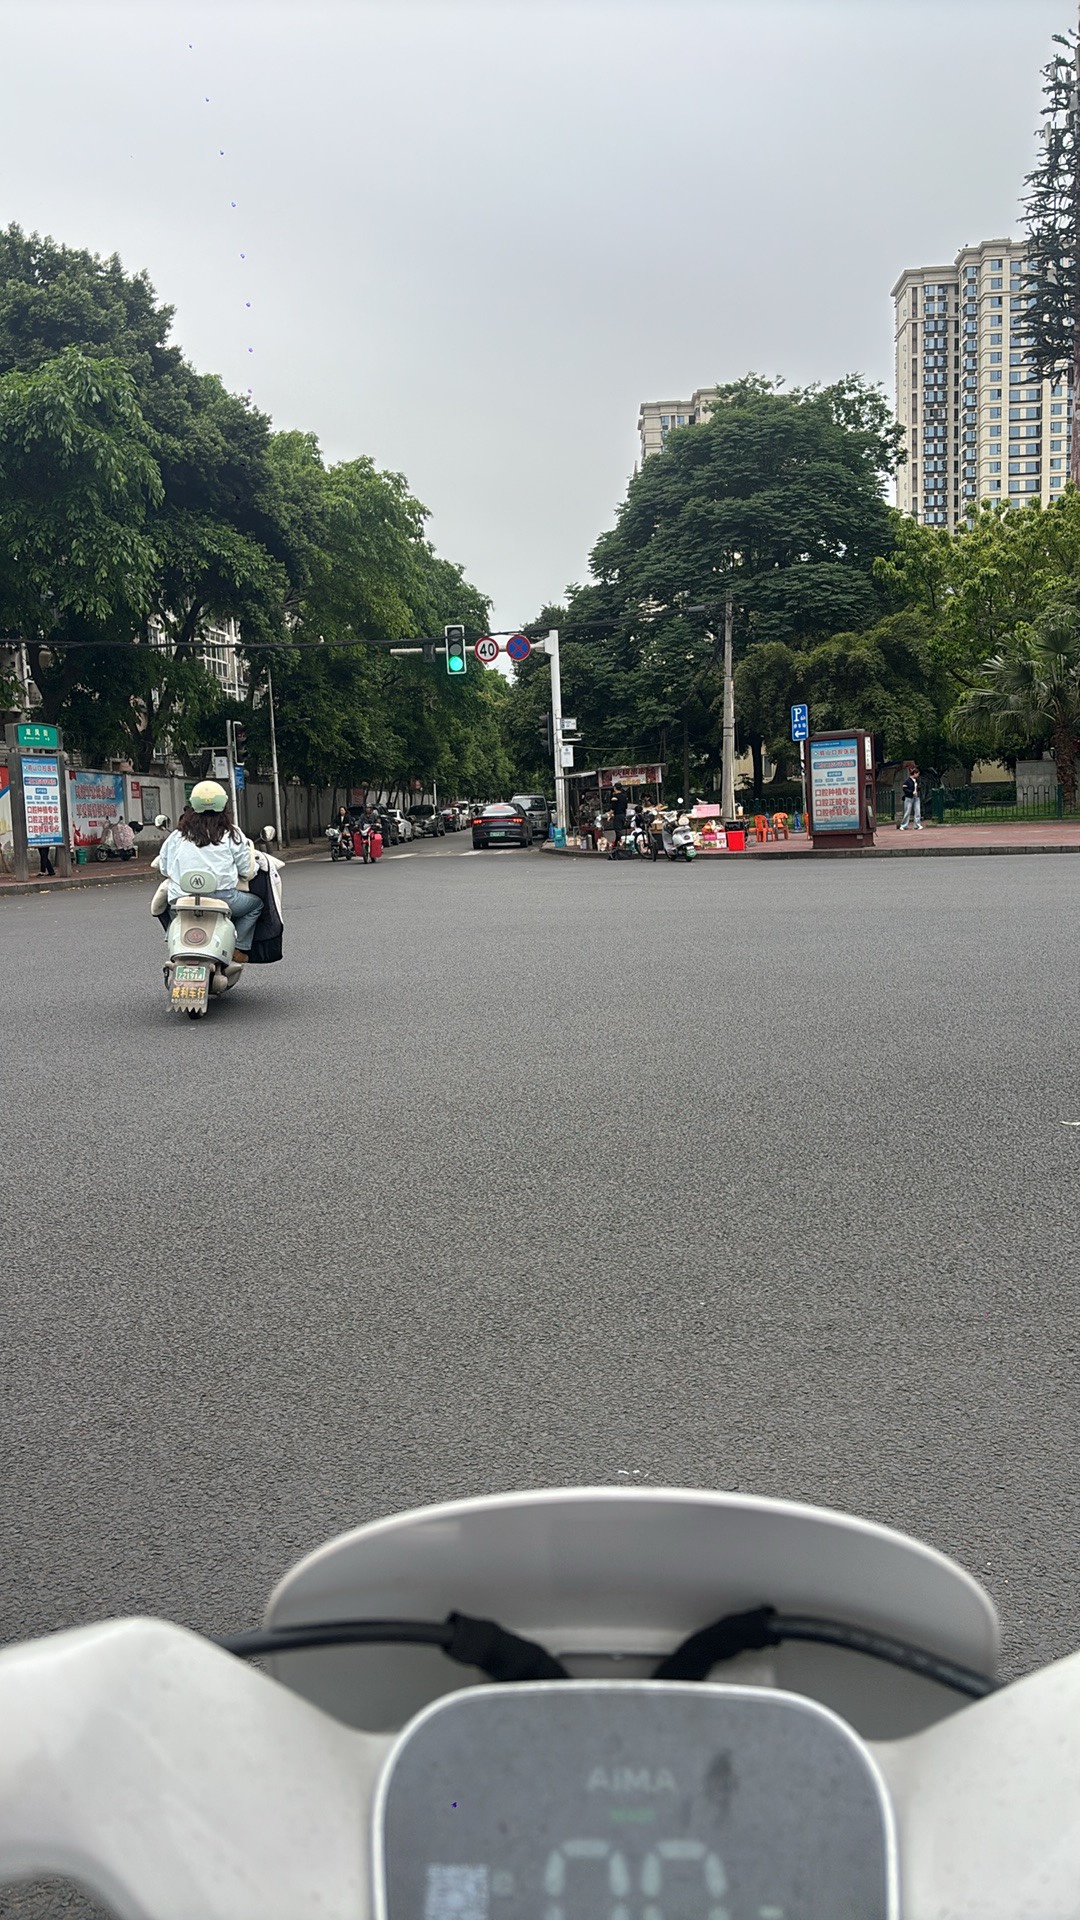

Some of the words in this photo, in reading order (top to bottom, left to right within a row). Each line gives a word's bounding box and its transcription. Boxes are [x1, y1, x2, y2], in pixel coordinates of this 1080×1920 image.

[479, 643, 495, 657] 40
[793, 707, 802, 722] P
[586, 1765, 679, 1793] AIMA
